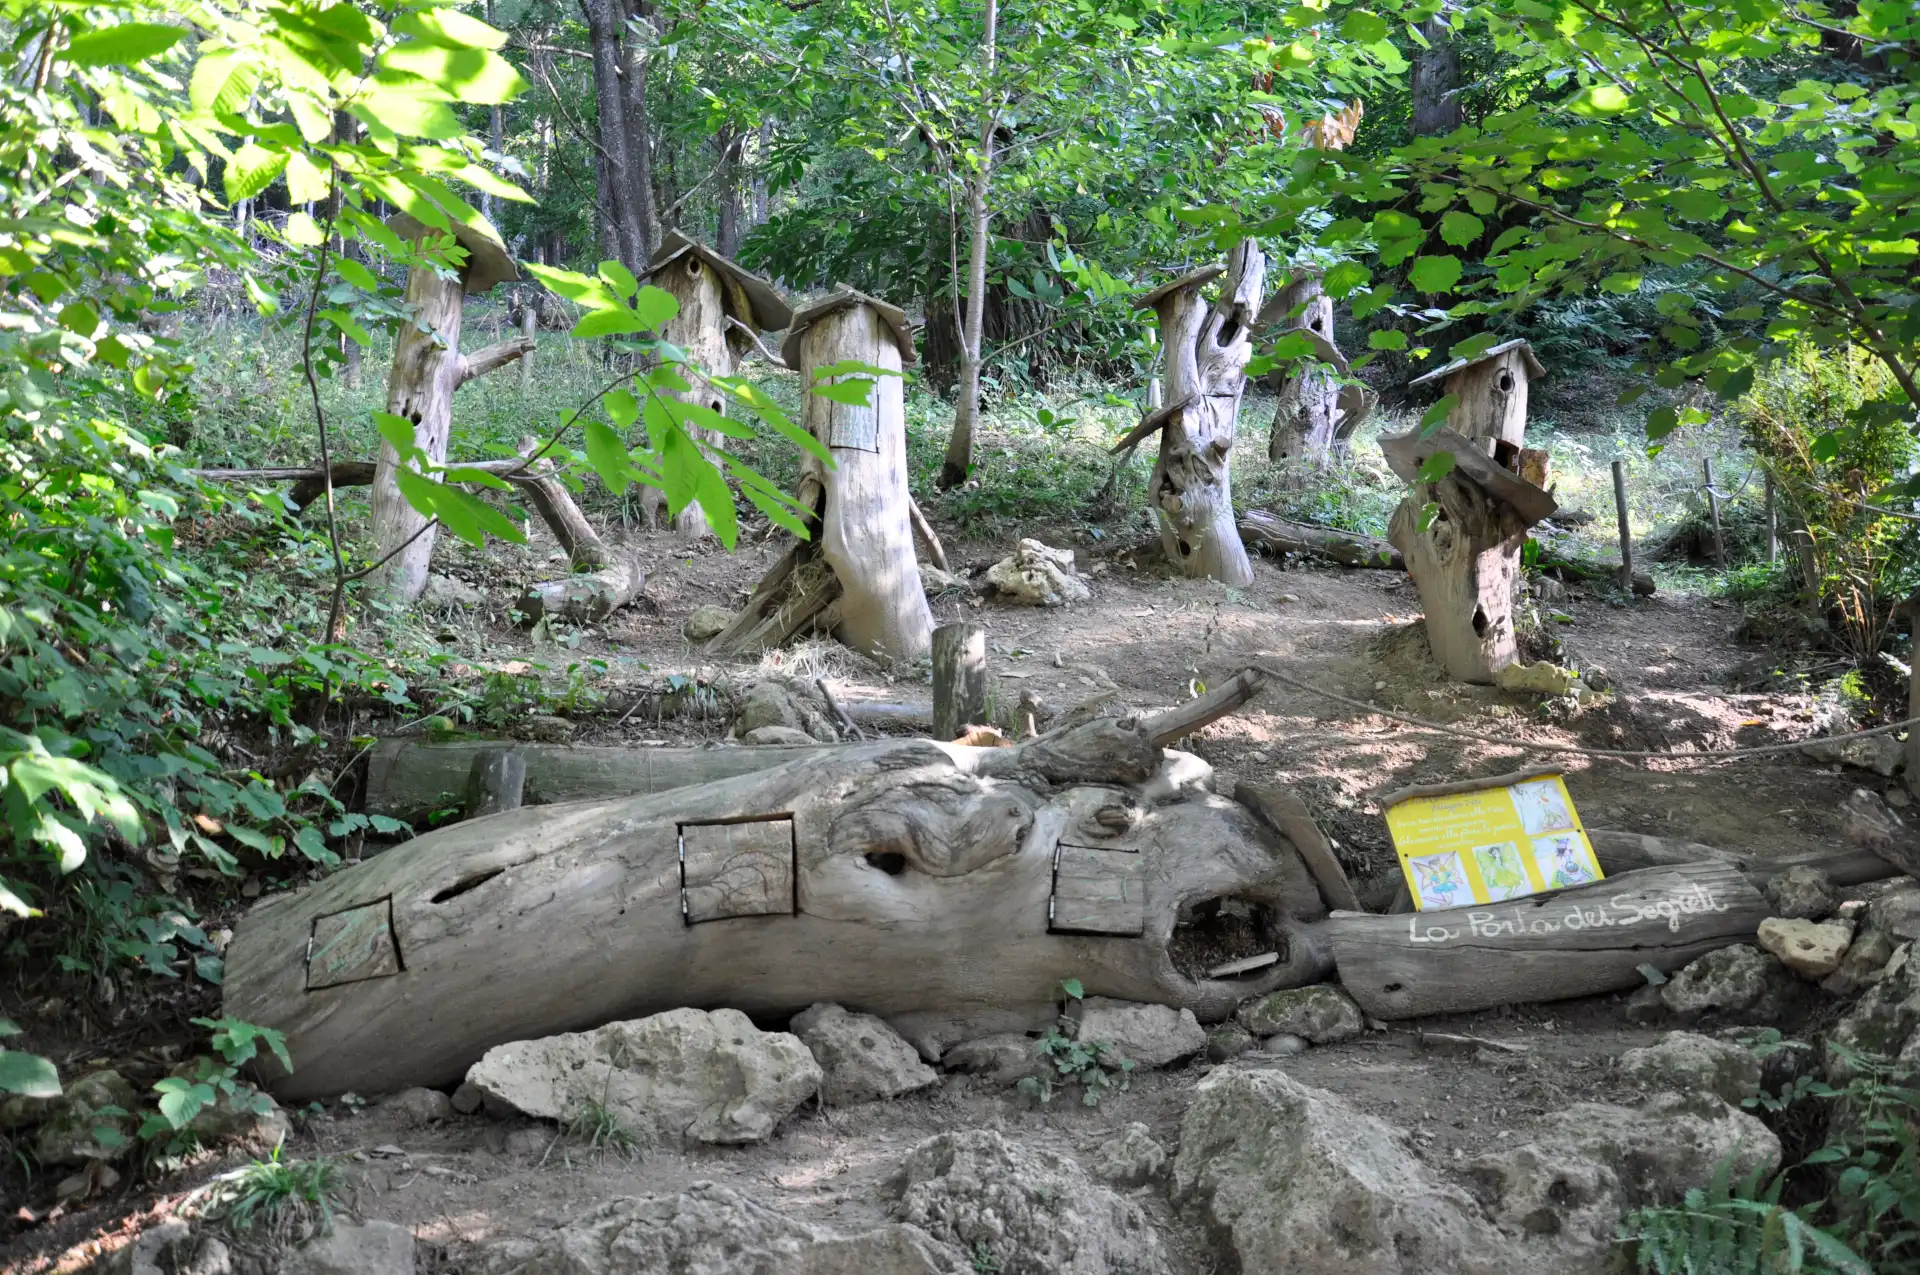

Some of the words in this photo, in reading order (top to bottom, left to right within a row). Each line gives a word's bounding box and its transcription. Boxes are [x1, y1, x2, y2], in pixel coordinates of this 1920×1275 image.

[1409, 917, 1459, 943] La
[1468, 908, 1561, 937] Porta
[1563, 905, 1615, 930] dei
[1611, 884, 1729, 933] Segreti
